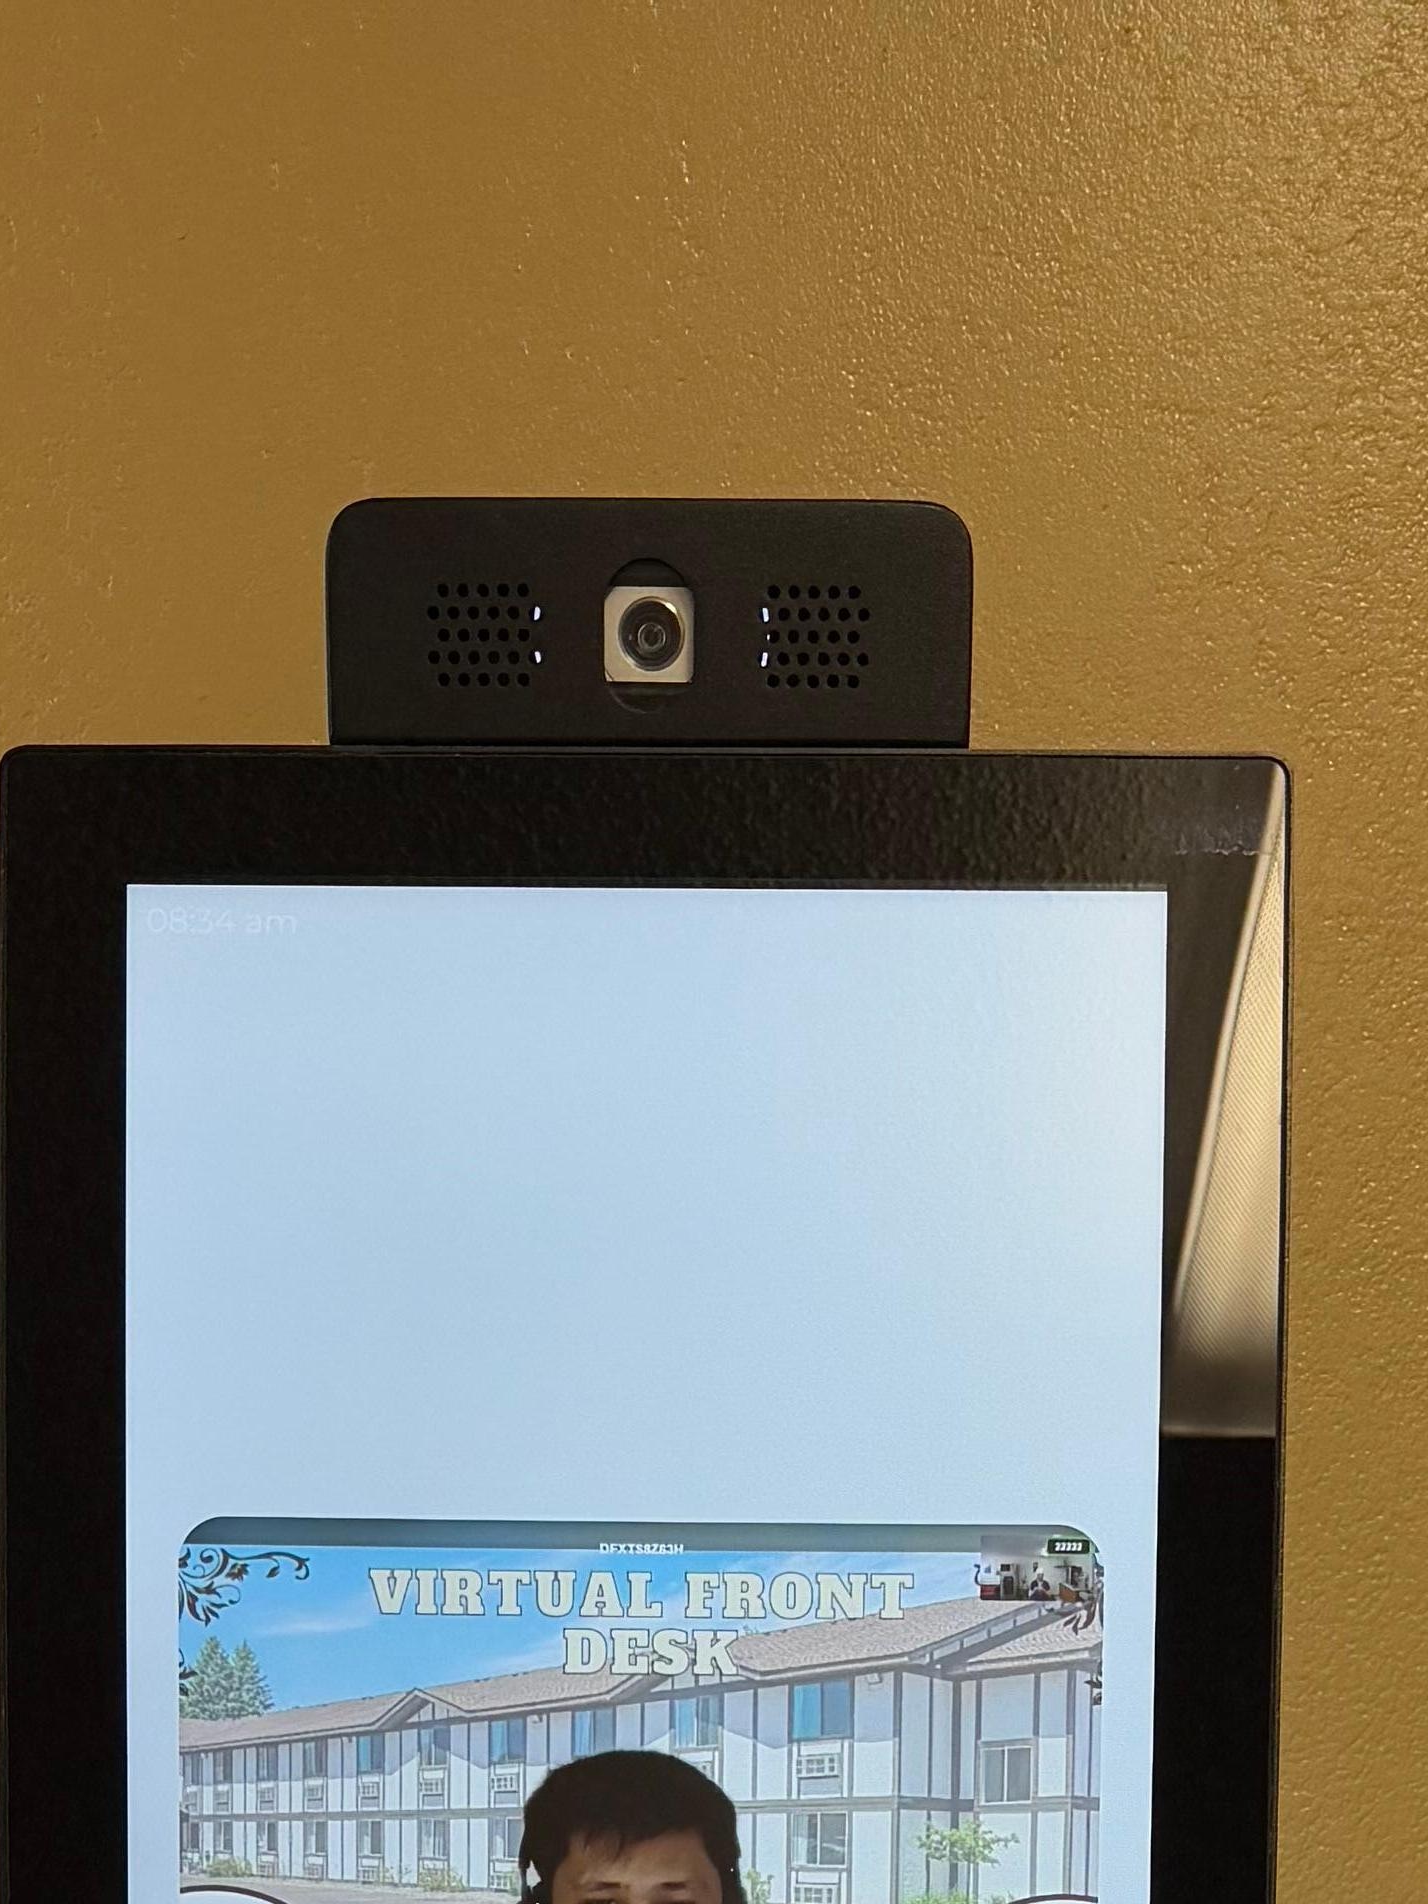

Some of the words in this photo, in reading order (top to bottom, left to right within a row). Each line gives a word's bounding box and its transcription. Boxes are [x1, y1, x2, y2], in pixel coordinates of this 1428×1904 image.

[245, 912, 299, 935] am
[368, 1568, 664, 1618] VIRTUAL
[684, 1571, 915, 1620] FRONT
[563, 1626, 740, 1676] DESK
